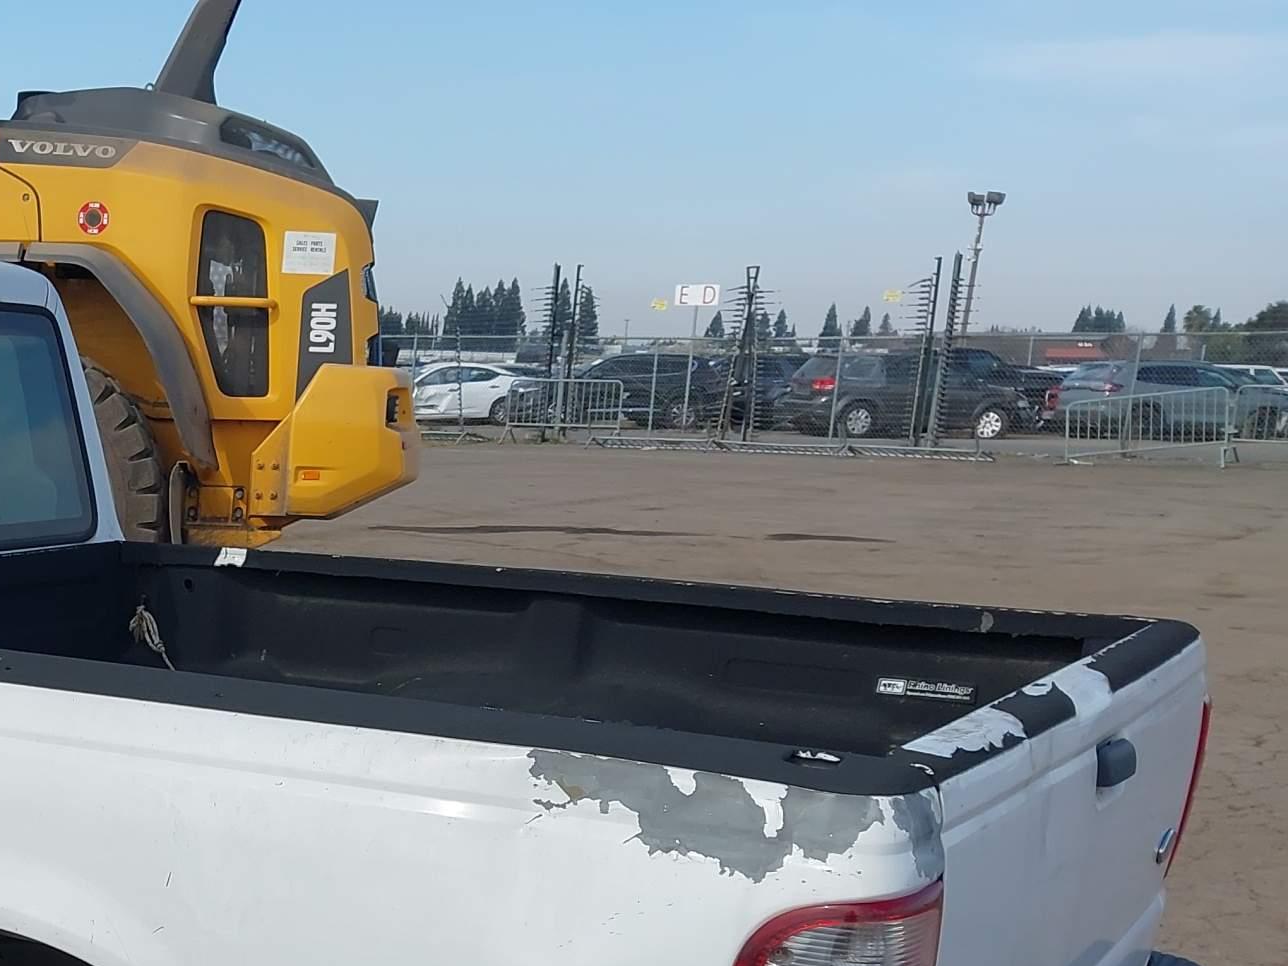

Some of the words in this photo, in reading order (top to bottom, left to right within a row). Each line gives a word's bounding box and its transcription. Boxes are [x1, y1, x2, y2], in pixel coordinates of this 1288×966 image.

[8, 139, 116, 158] VOLVO
[679, 286, 690, 304] E
[702, 286, 716, 304] D
[308, 303, 337, 353] L90H
